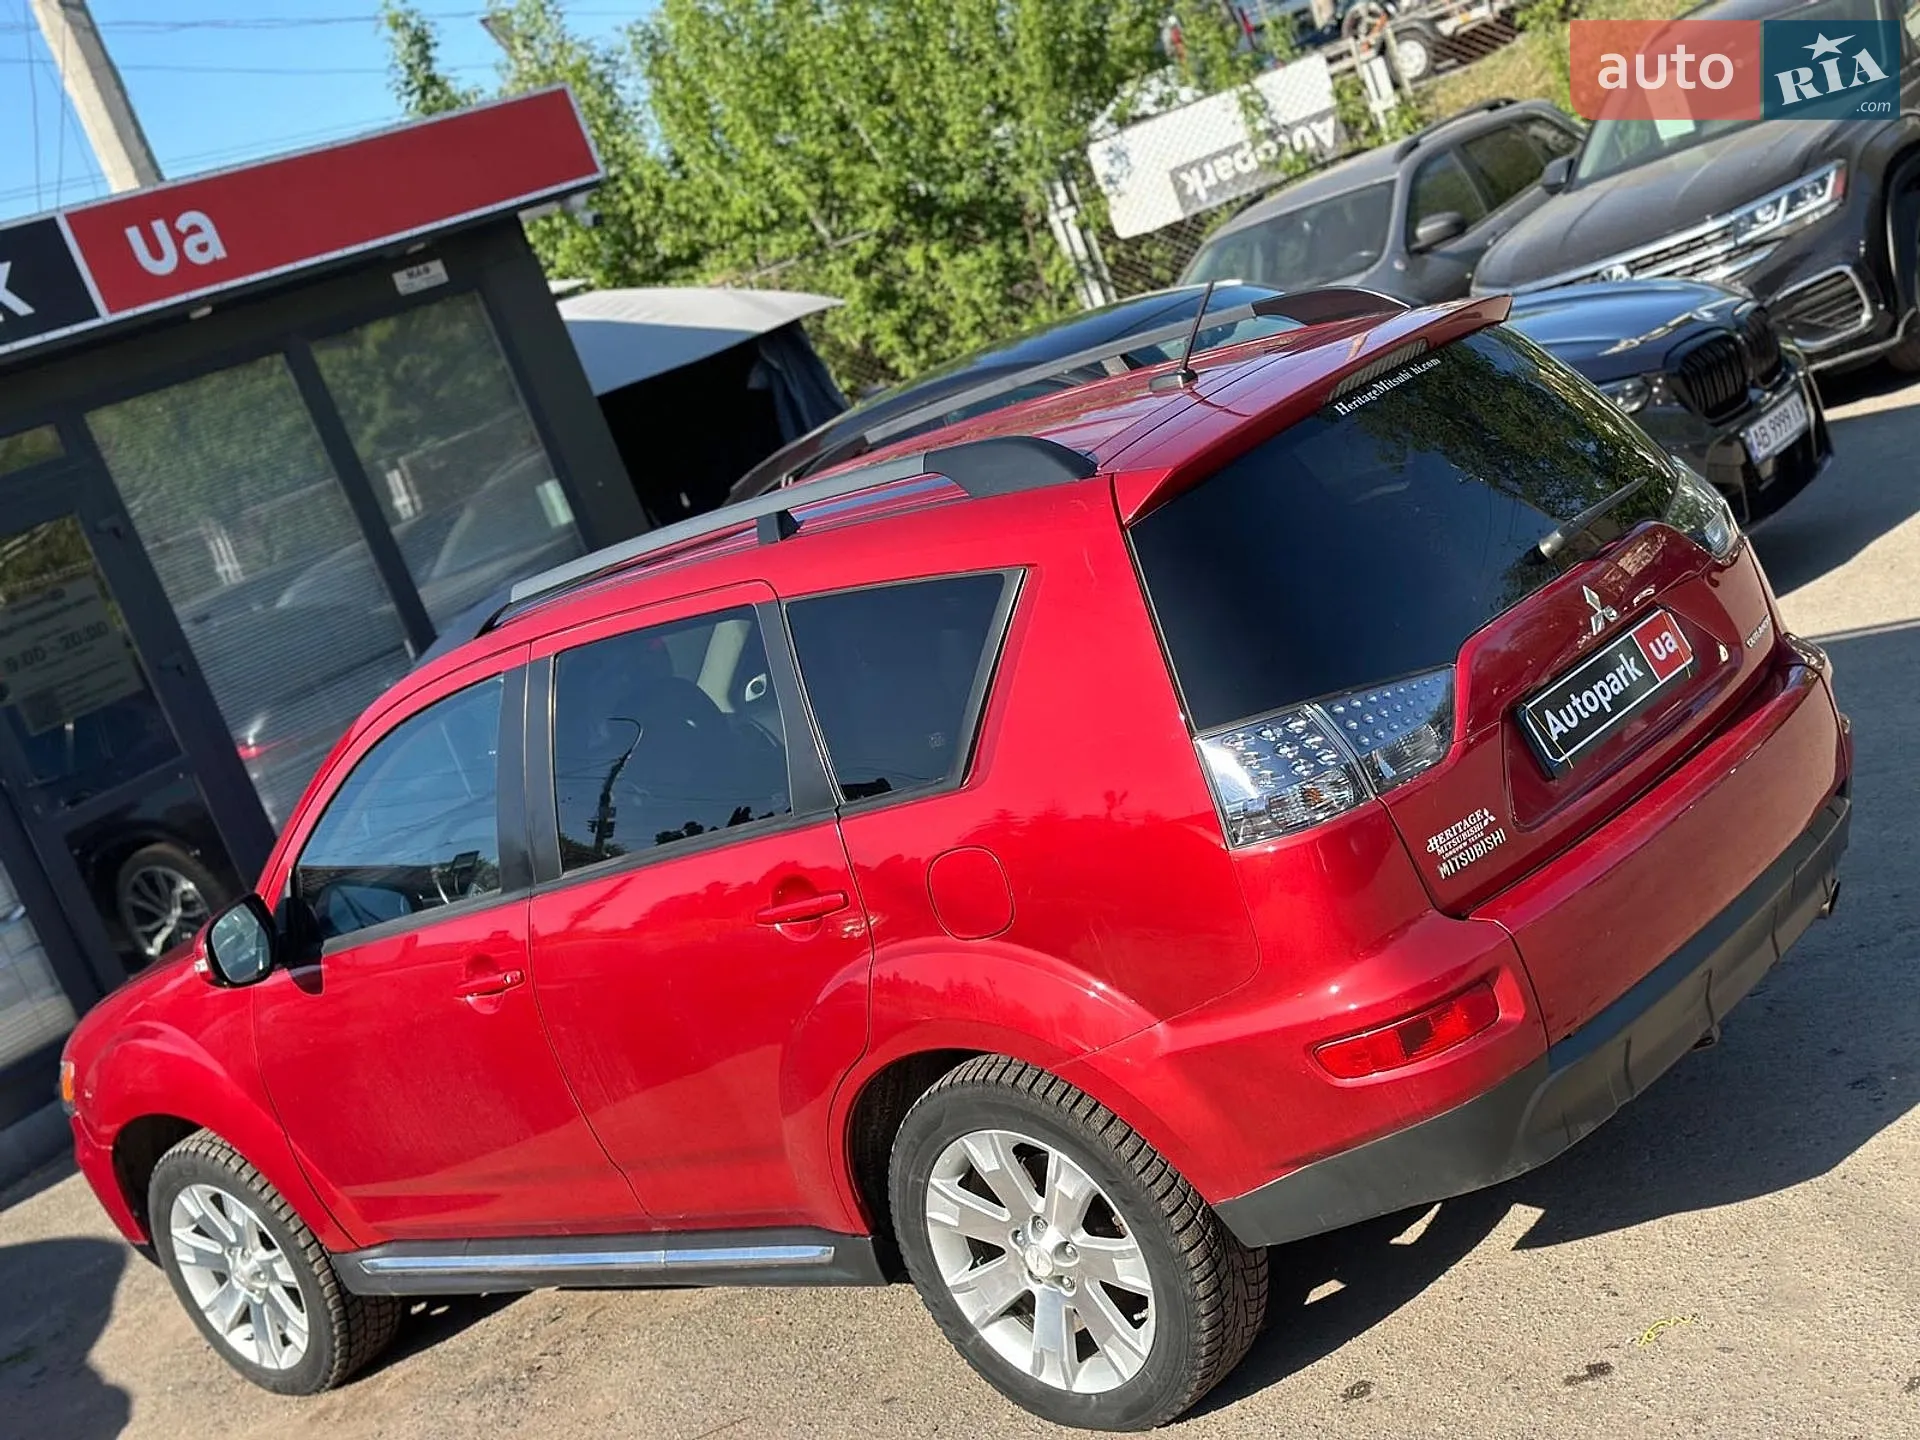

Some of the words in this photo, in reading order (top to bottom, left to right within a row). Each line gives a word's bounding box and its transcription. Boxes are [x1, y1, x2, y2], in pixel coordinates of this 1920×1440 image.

[124, 210, 228, 276] ua
[1544, 653, 1644, 741] Autopark
[1648, 631, 1679, 661] ua
[1426, 808, 1484, 853] HERITAGE
[1437, 827, 1506, 880] MITSUBISHI
